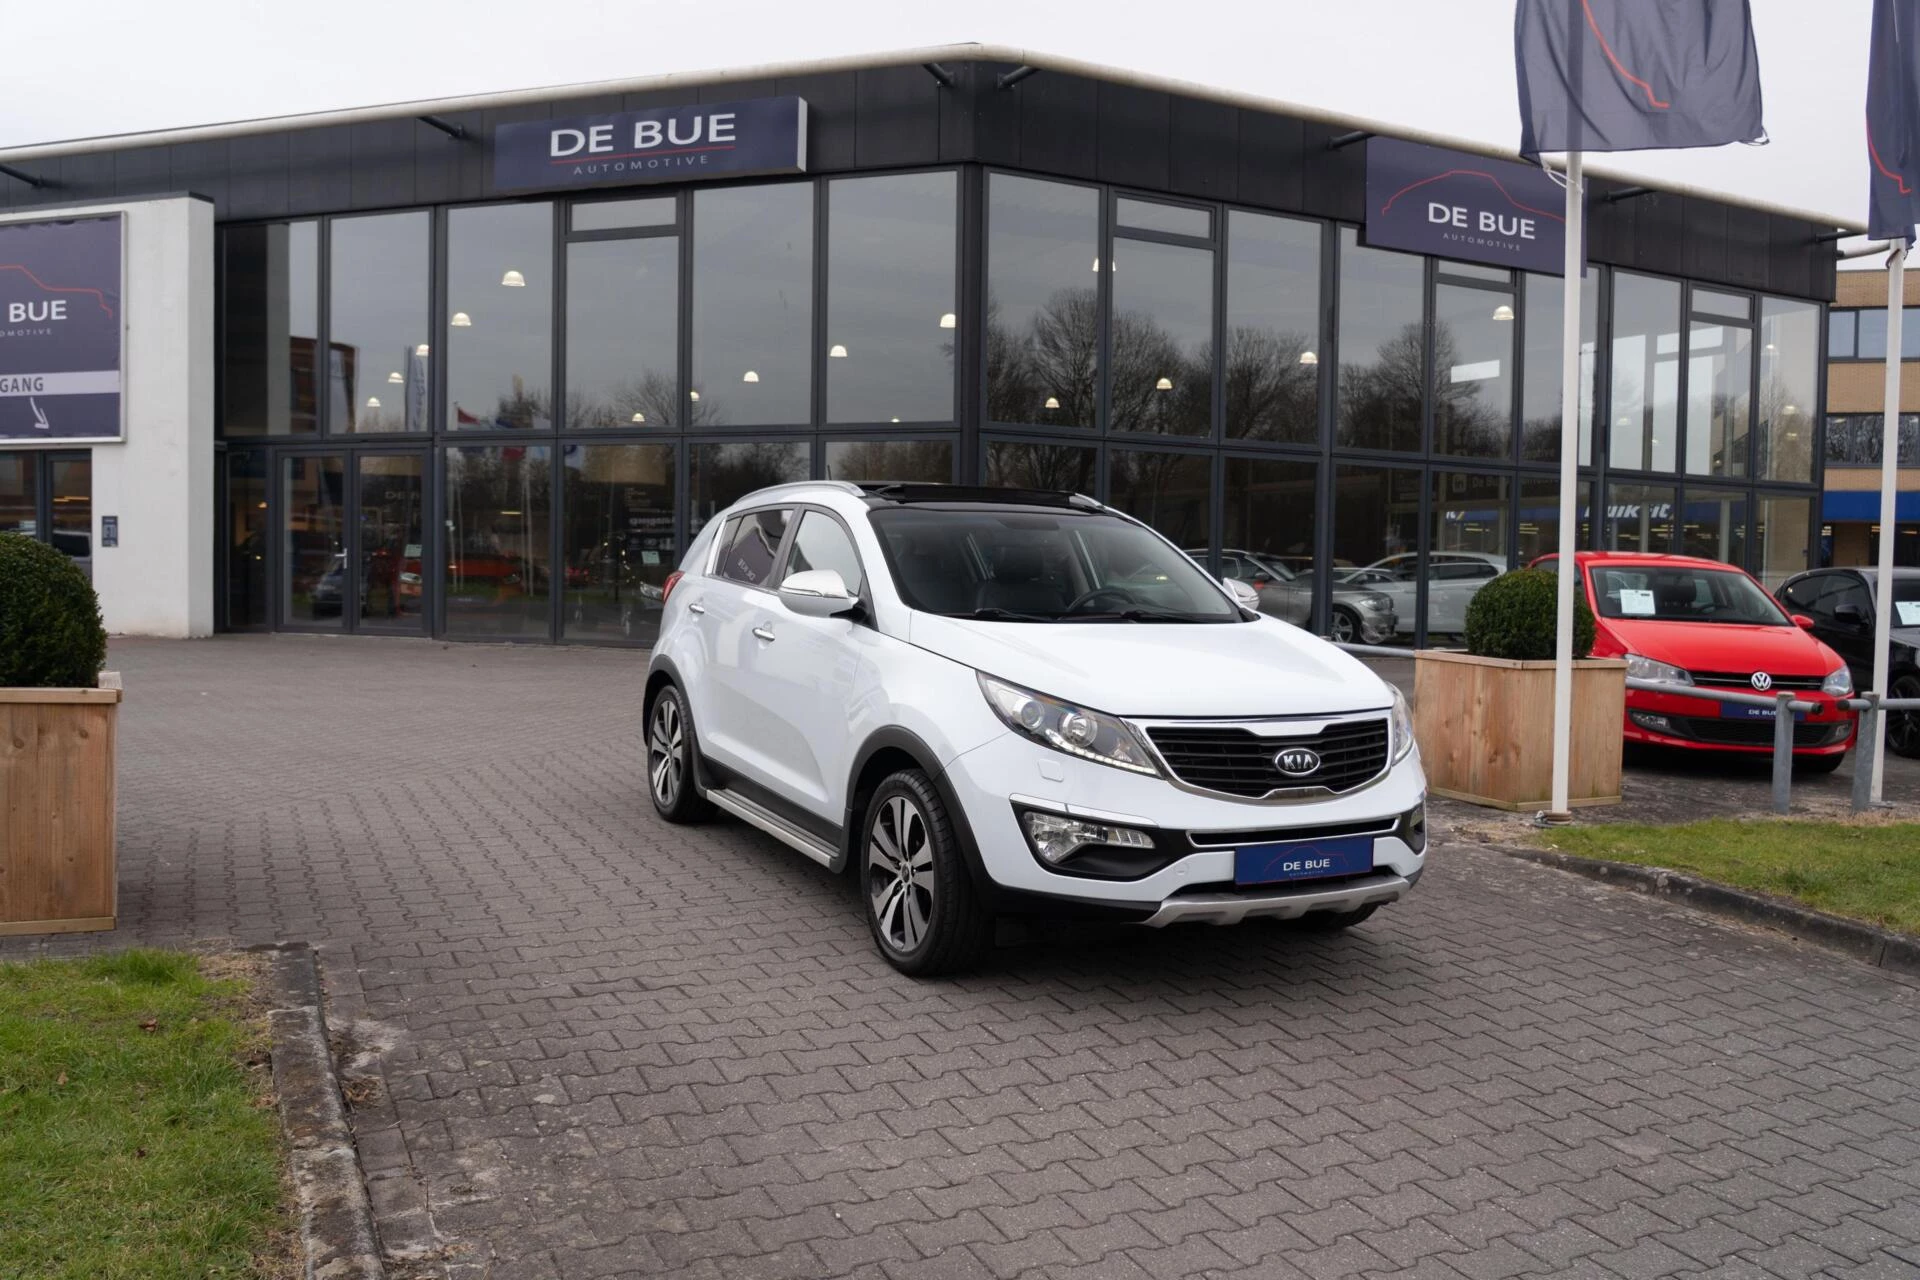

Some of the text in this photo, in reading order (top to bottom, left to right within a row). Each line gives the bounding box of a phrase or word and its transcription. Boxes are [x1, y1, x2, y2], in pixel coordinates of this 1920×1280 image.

[550, 113, 736, 157] DE BUE
[573, 155, 708, 175] AUTOMOTIVE
[1428, 202, 1536, 240] DE BUE
[1443, 232, 1521, 251] AUTOMOTIVE
[9, 299, 68, 323] BUE
[1283, 753, 1314, 770] KIA
[1283, 858, 1331, 872] DE BUE
